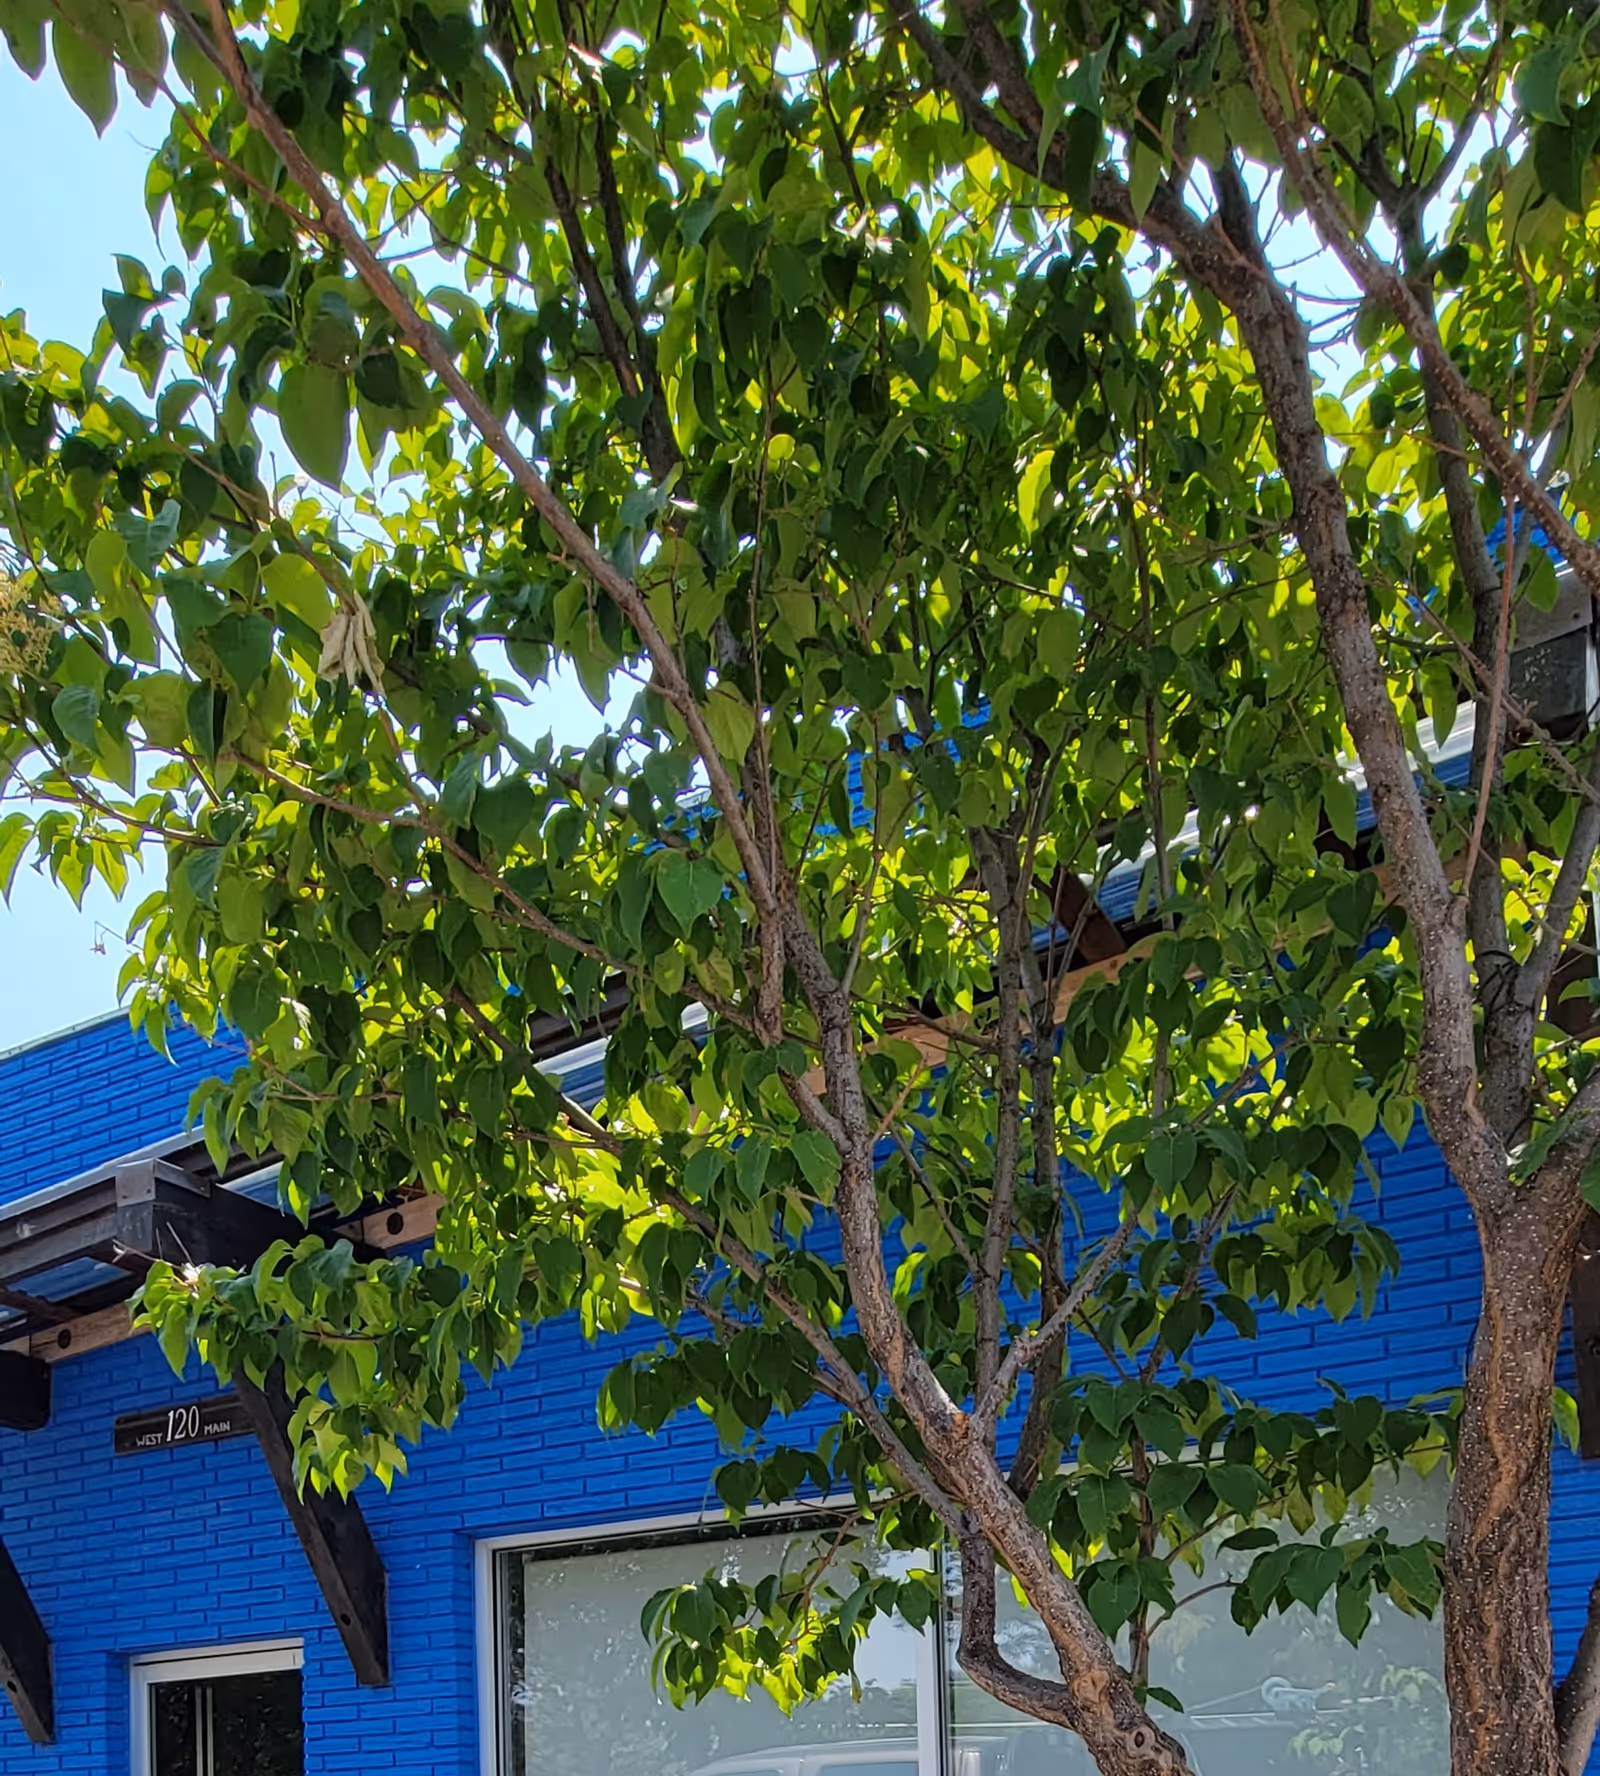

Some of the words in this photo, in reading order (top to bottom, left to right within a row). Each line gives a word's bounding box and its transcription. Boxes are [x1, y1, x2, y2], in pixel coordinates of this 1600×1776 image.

[135, 1432, 163, 1447] WEST
[166, 1405, 200, 1442] 120
[203, 1420, 231, 1436] MAIN
